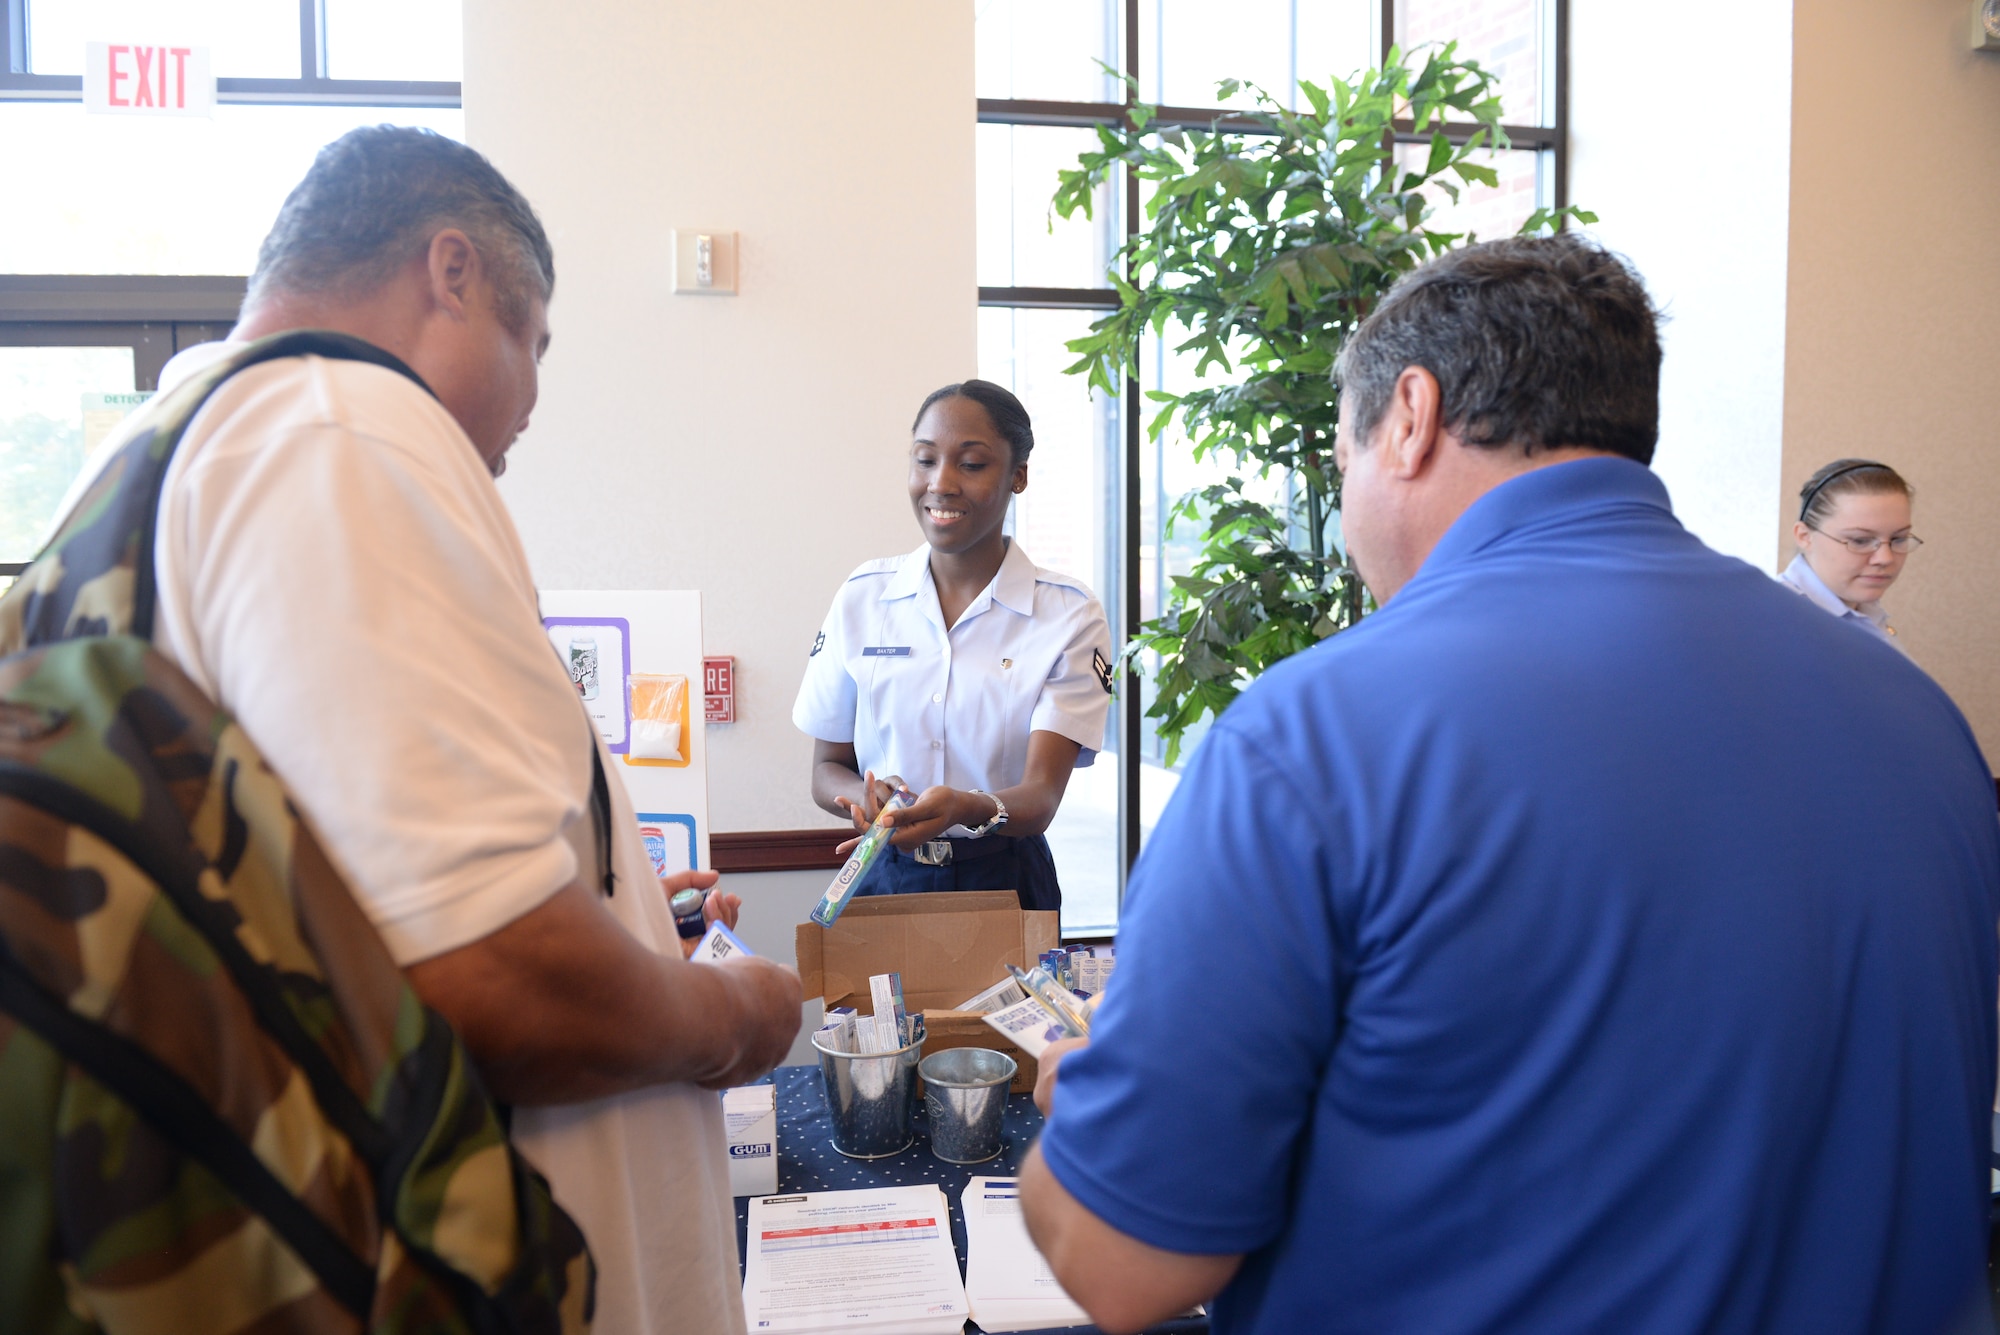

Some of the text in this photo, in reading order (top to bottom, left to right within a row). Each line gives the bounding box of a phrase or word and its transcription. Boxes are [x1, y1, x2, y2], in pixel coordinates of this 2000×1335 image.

[108, 45, 191, 109] EXIT
[706, 667, 728, 692] RE
[711, 932, 732, 958] QUIT
